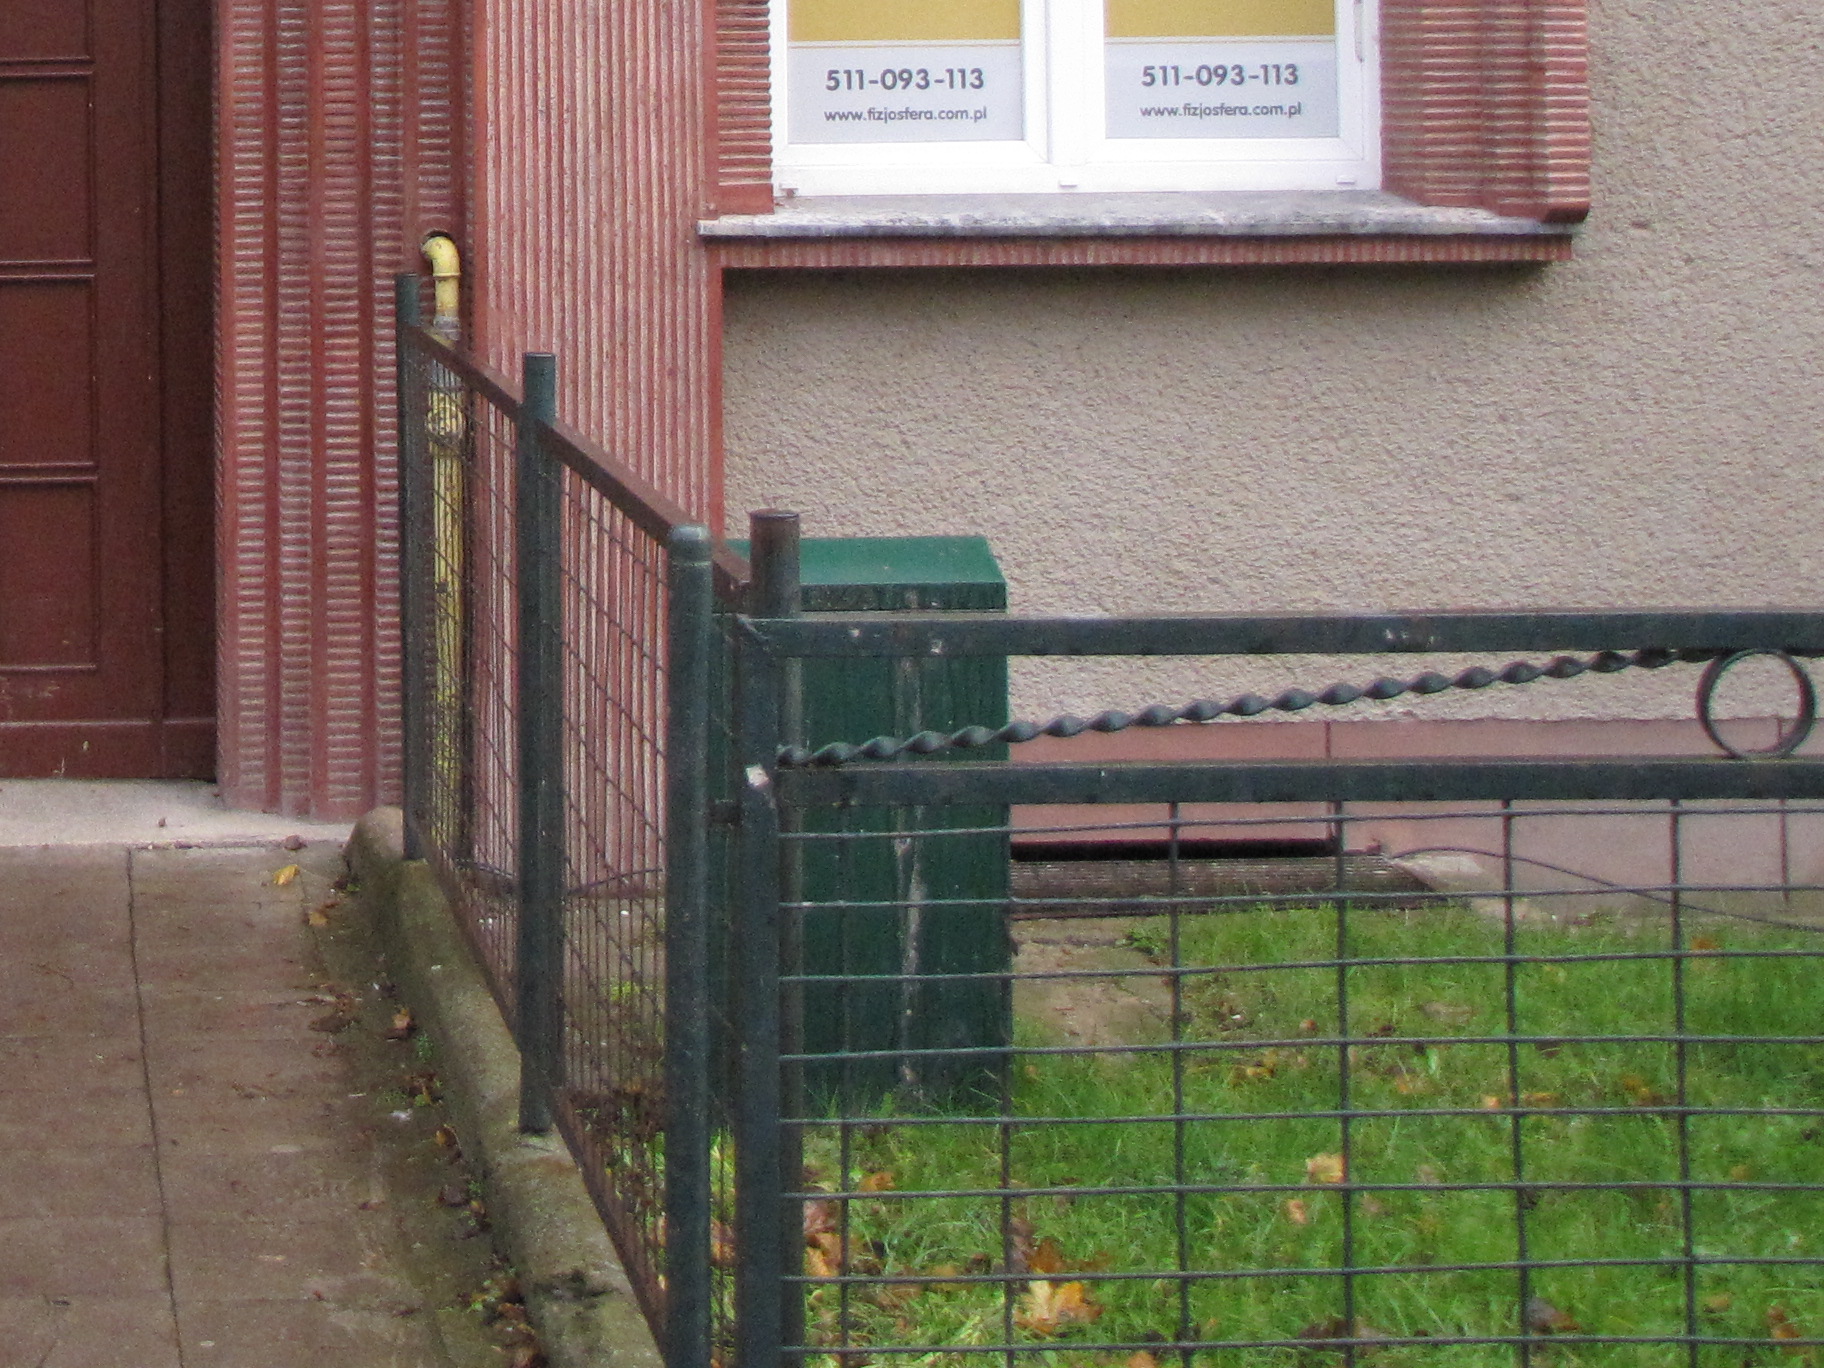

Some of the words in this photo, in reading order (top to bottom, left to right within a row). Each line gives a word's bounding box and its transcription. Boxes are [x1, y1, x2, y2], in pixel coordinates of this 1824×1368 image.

[825, 68, 984, 91] 511-093-113
[1141, 64, 1299, 87] 511-093-113
[824, 106, 987, 124] www.fizjosfera.com.pl
[1139, 102, 1302, 119] www.fizjosfera.com.pl
